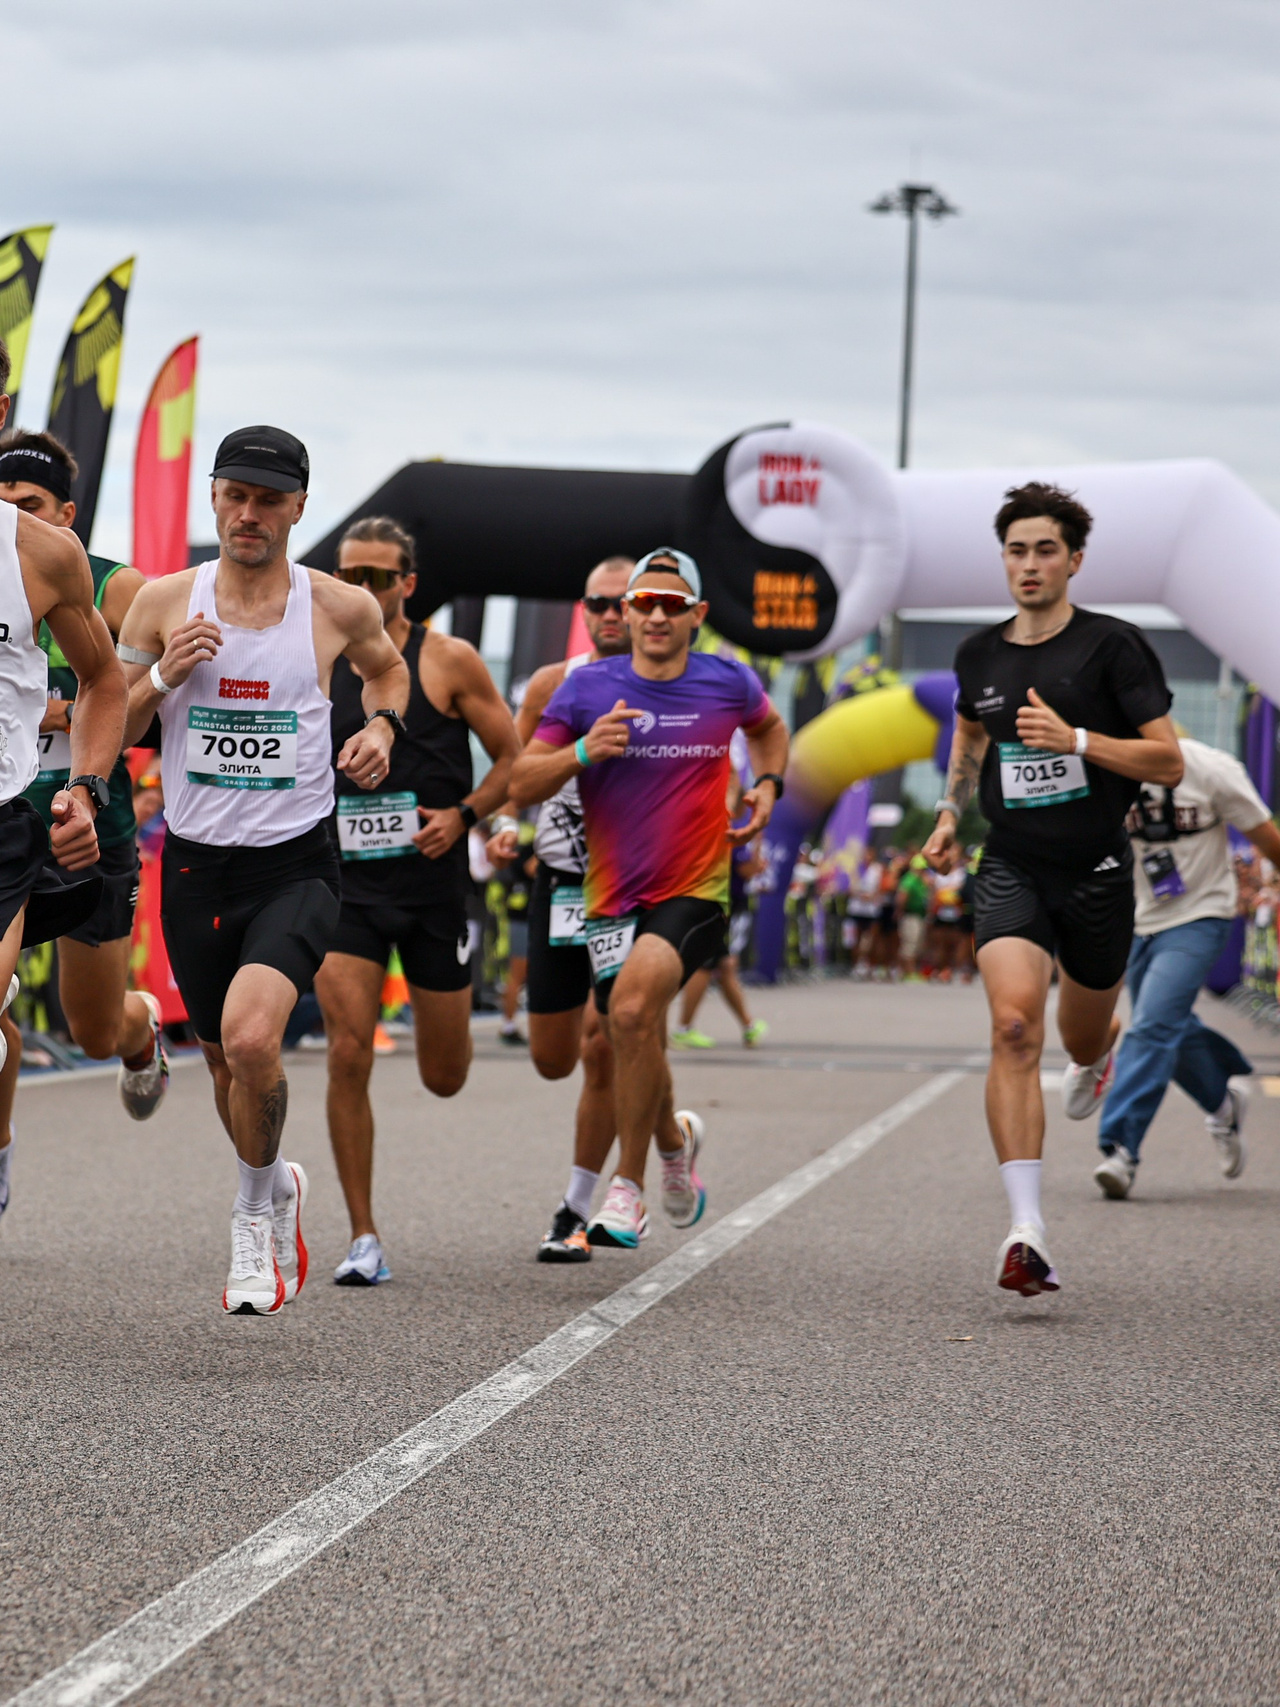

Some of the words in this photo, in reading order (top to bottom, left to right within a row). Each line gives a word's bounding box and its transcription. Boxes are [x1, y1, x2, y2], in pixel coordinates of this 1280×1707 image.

[759, 479, 820, 507] LADY
[753, 597, 817, 630] STAR
[218, 687, 270, 700] RELIGION
[219, 677, 271, 691] RUNNING
[192, 720, 231, 731] MANSTAR
[233, 724, 269, 732] СИРИУС
[270, 724, 293, 732] 2026
[202, 734, 280, 759] 7002
[218, 763, 262, 774] ЭЛИТА
[1012, 760, 1067, 783] 7015
[347, 815, 403, 836] 7012
